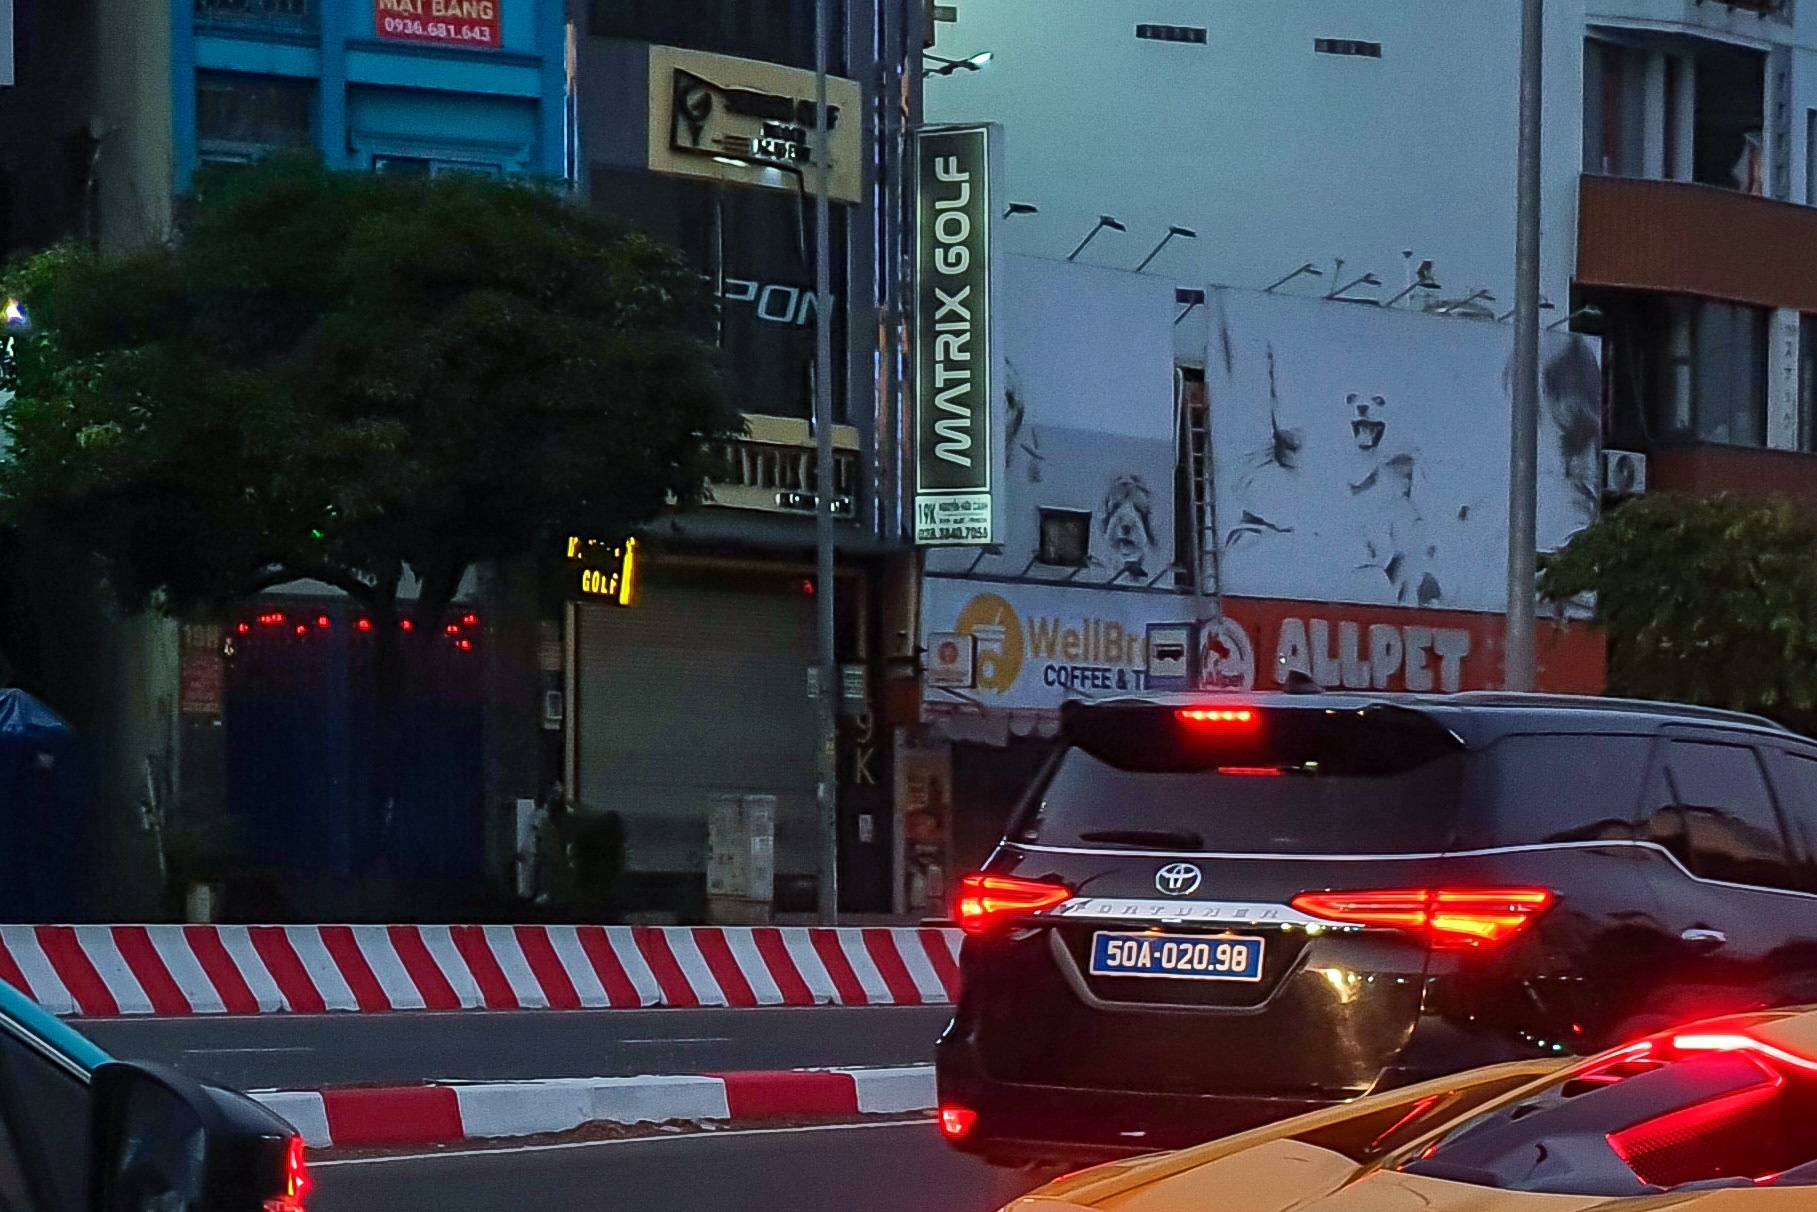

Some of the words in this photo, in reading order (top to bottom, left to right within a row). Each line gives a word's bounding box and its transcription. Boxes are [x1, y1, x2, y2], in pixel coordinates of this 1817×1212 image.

[935, 155, 971, 276] GOLF
[935, 286, 972, 467] MATRIX
[582, 569, 619, 594] GOLF
[1026, 615, 1147, 664] WellBr
[1276, 617, 1471, 692] ALLPET
[1043, 664, 1112, 690] COFFEE
[1115, 668, 1127, 690] &
[1131, 669, 1147, 690] T
[1106, 940, 1247, 972] 50A-020.98
